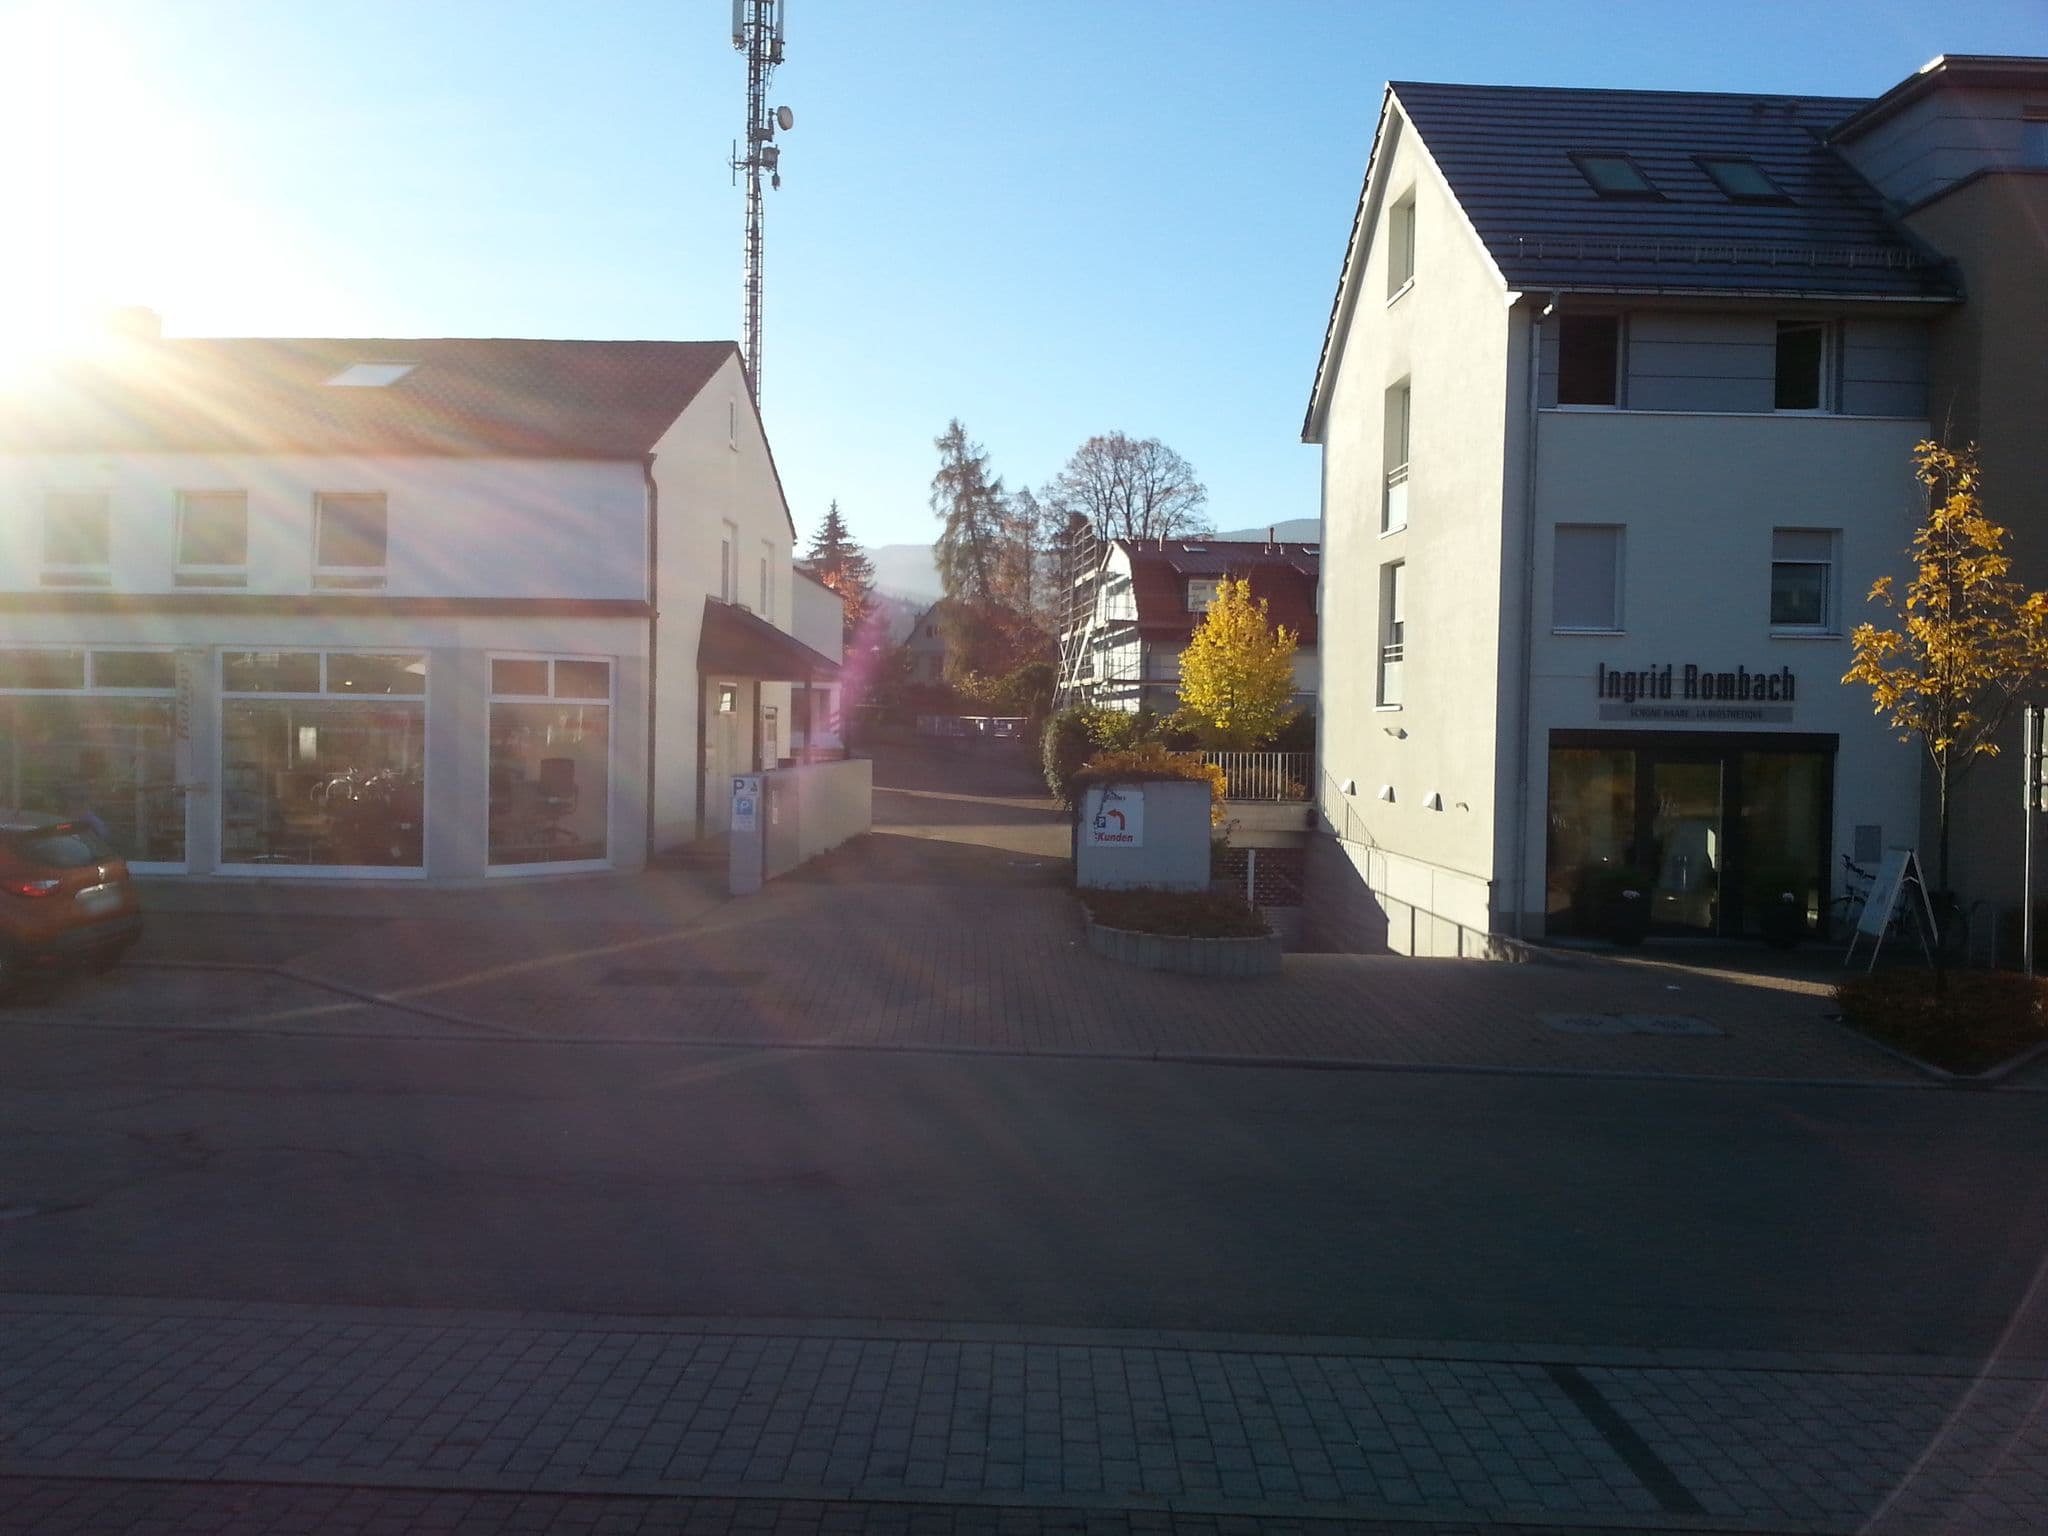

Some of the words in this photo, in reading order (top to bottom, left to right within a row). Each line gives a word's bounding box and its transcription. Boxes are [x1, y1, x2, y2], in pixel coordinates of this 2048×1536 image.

[1599, 662, 1671, 702] Ingrid
[1685, 663, 1795, 701] Rombach
[733, 779, 745, 795] P
[1097, 832, 1133, 842] Kunden
